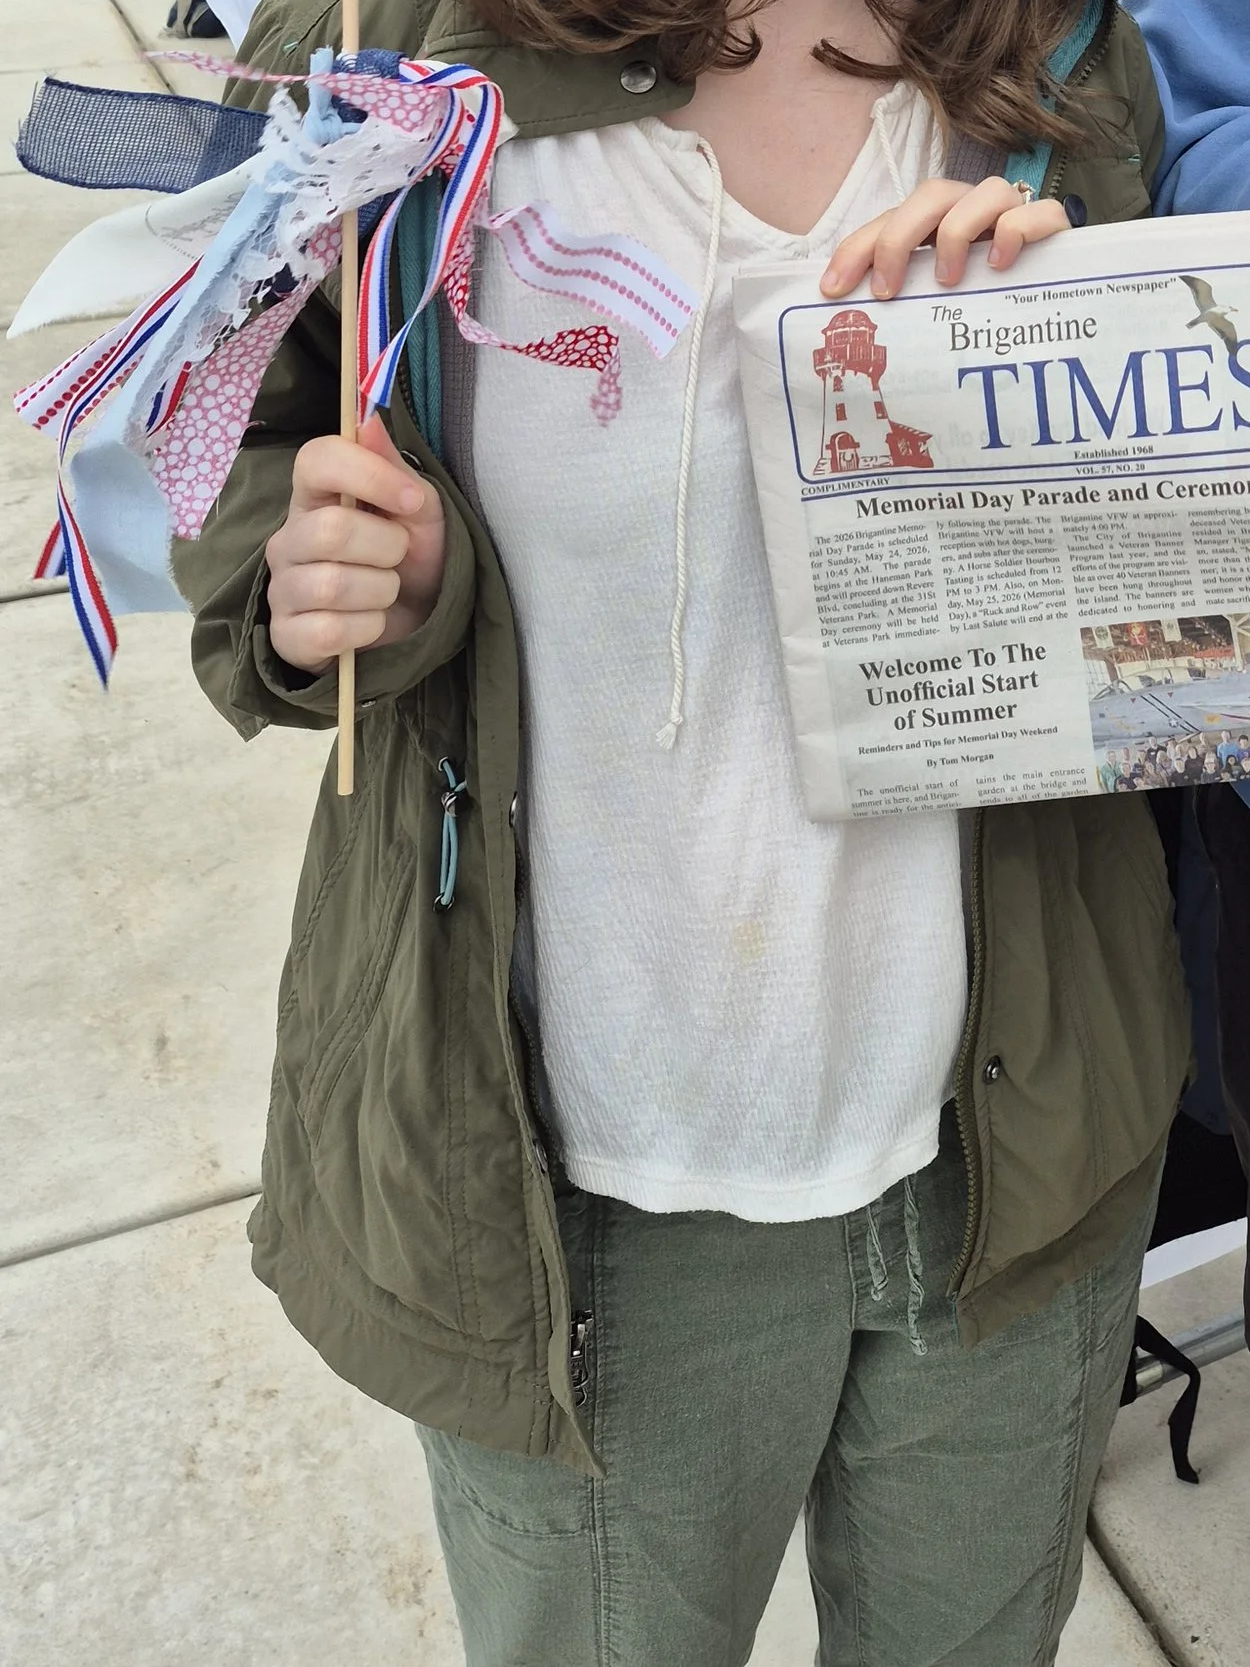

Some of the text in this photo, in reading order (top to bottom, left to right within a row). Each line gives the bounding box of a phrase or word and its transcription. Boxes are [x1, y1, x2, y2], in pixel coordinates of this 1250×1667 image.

[1005, 278, 1176, 305] "Your Hometown Newspaper"
[931, 305, 963, 322] The
[950, 311, 1098, 356] Brigantine
[1074, 446, 1154, 460] Established 1968
[1102, 466, 1114, 474] 57,
[1116, 464, 1132, 472] NO.
[801, 477, 890, 496] COMPLIMENTARY
[856, 491, 964, 518] Memorial
[972, 488, 1012, 512] Day
[1022, 486, 1100, 507] Parade
[1108, 482, 1149, 502] and
[858, 643, 1046, 681] Welcome To The
[866, 670, 1039, 706] Unofficial Start
[894, 703, 1018, 730] of Summer
[858, 726, 1058, 755] Reminders and Tips for Memorial Day Weekend
[926, 752, 994, 768] By Tom Morgan
